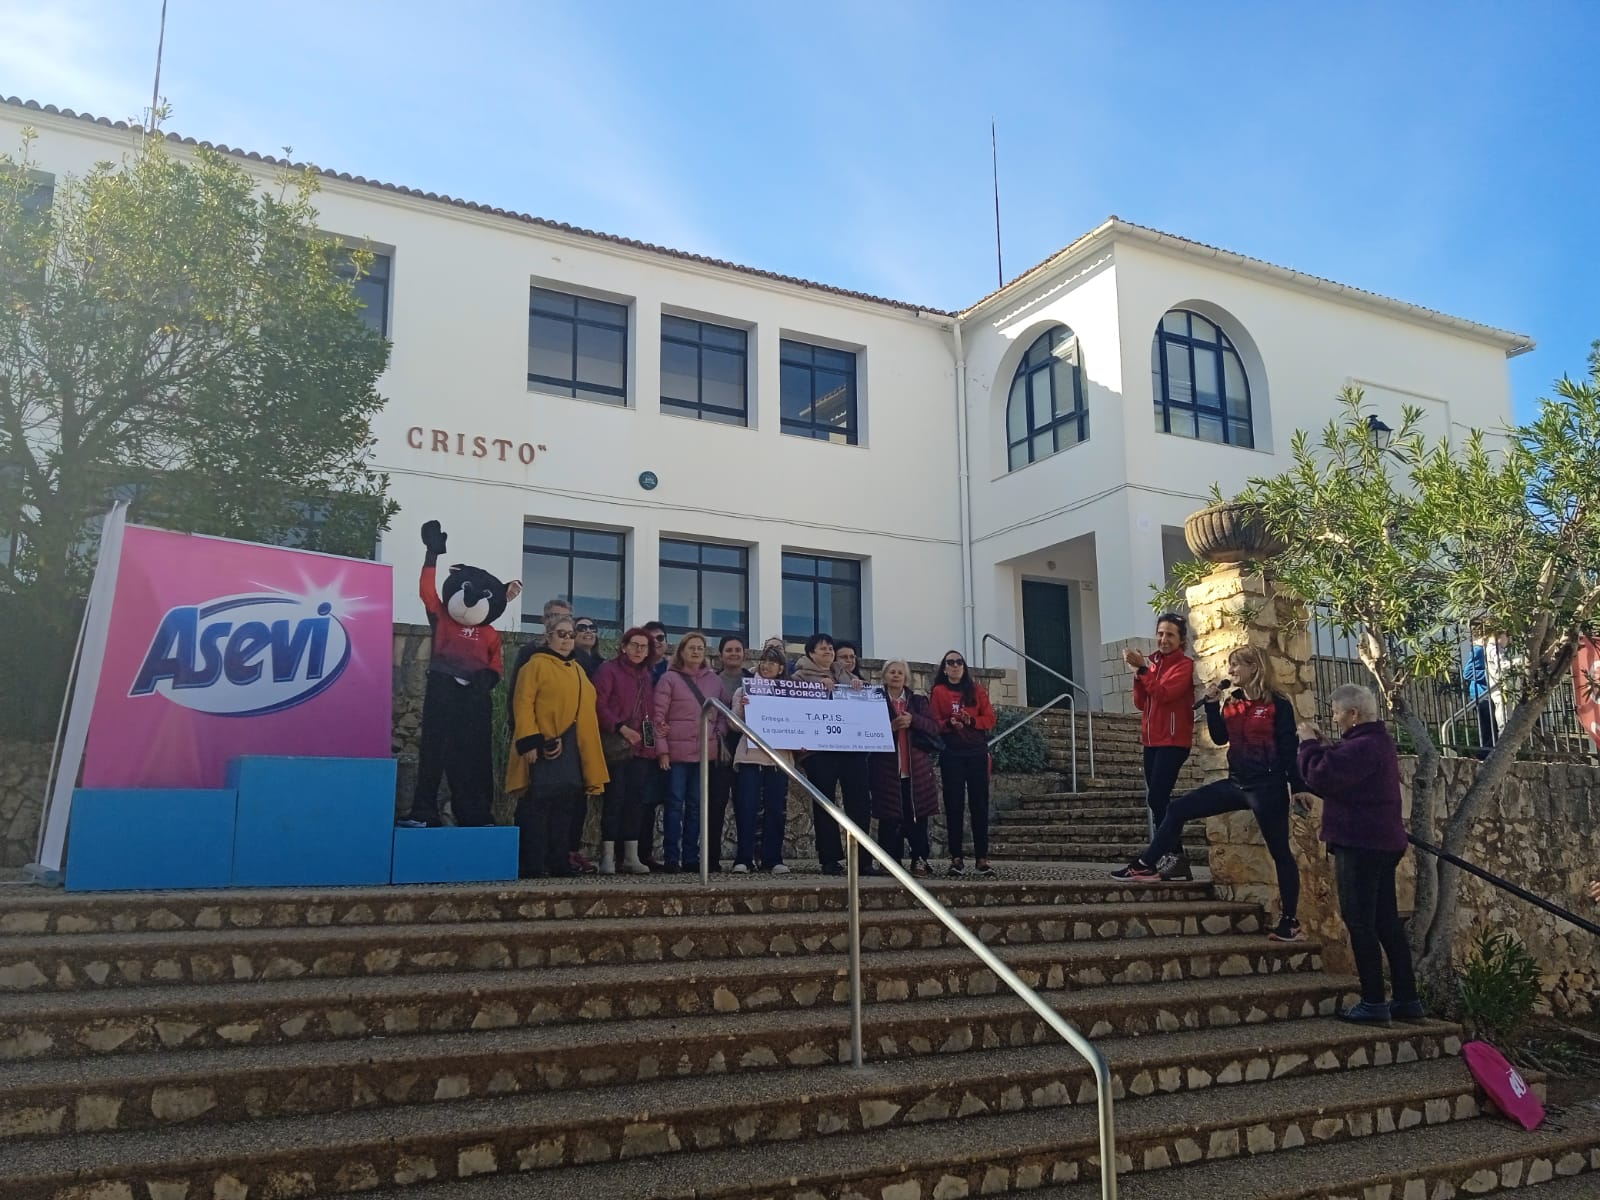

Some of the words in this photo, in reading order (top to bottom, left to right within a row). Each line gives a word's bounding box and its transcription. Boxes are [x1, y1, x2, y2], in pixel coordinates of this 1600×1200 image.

[128, 602, 331, 697] Asevi
[743, 678, 777, 686] CURSA
[780, 680, 828, 690] SOLIDARI
[749, 687, 773, 695] GATA
[789, 689, 827, 698] GORGOS
[826, 725, 842, 735] 900
